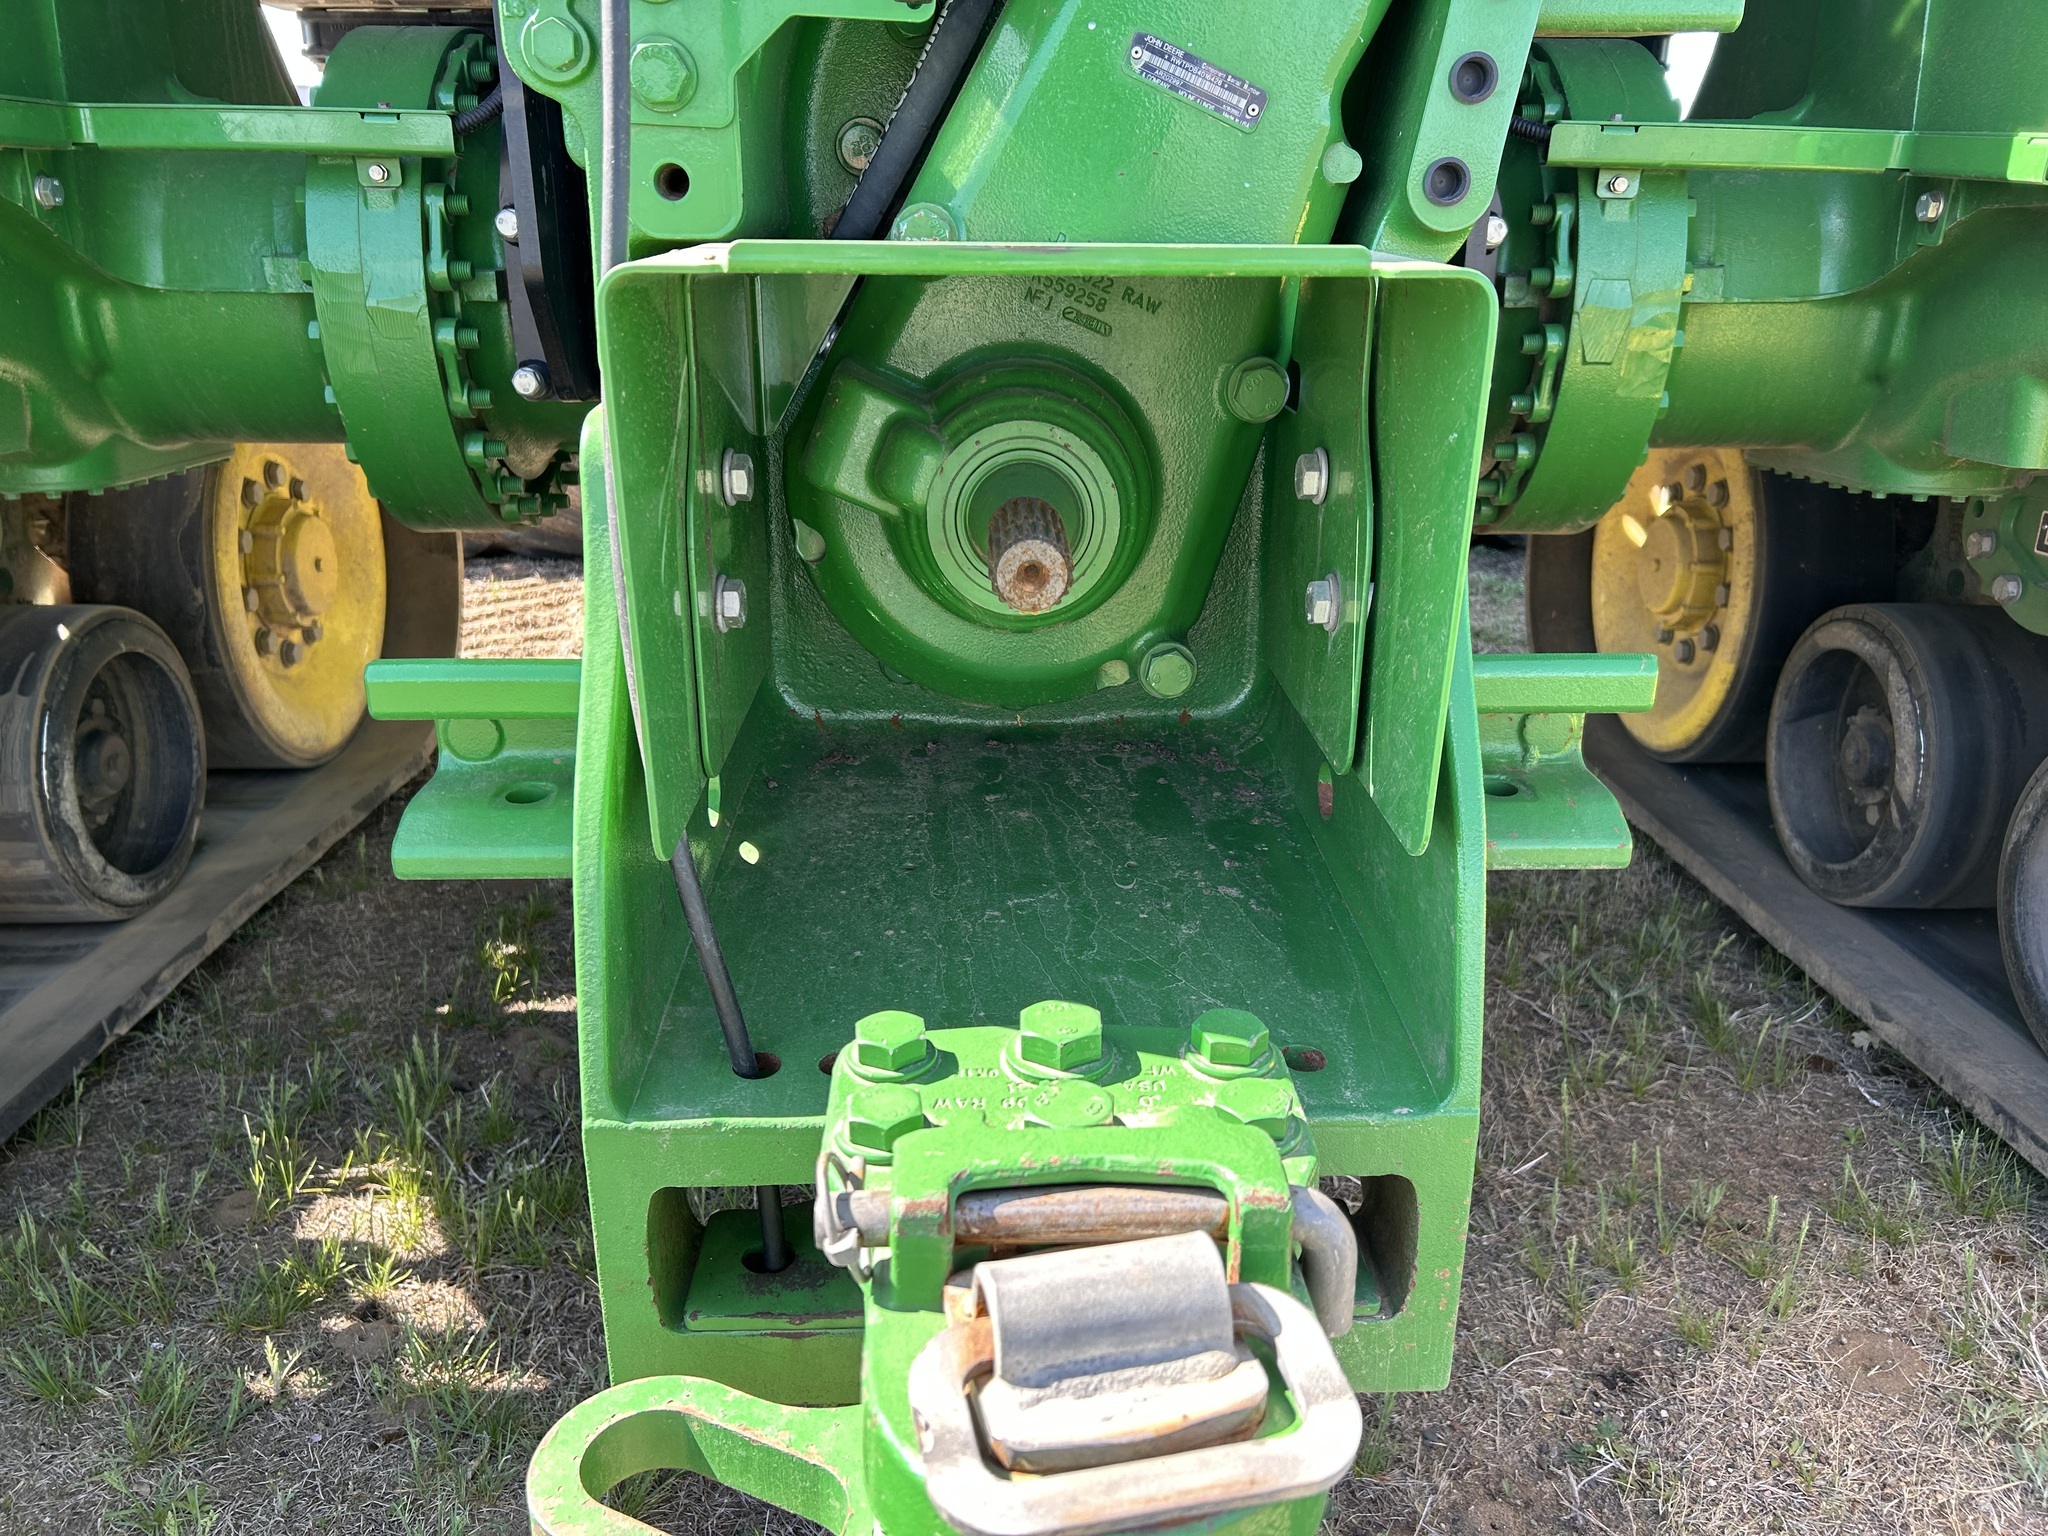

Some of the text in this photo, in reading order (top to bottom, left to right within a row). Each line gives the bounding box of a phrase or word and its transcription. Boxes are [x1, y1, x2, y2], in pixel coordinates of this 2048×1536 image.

[1144, 34, 1185, 58] JOHN DEERE
[1121, 286, 1163, 315] RAW
[1122, 1080, 1167, 1092] USA
[932, 1097, 987, 1110] RAW
